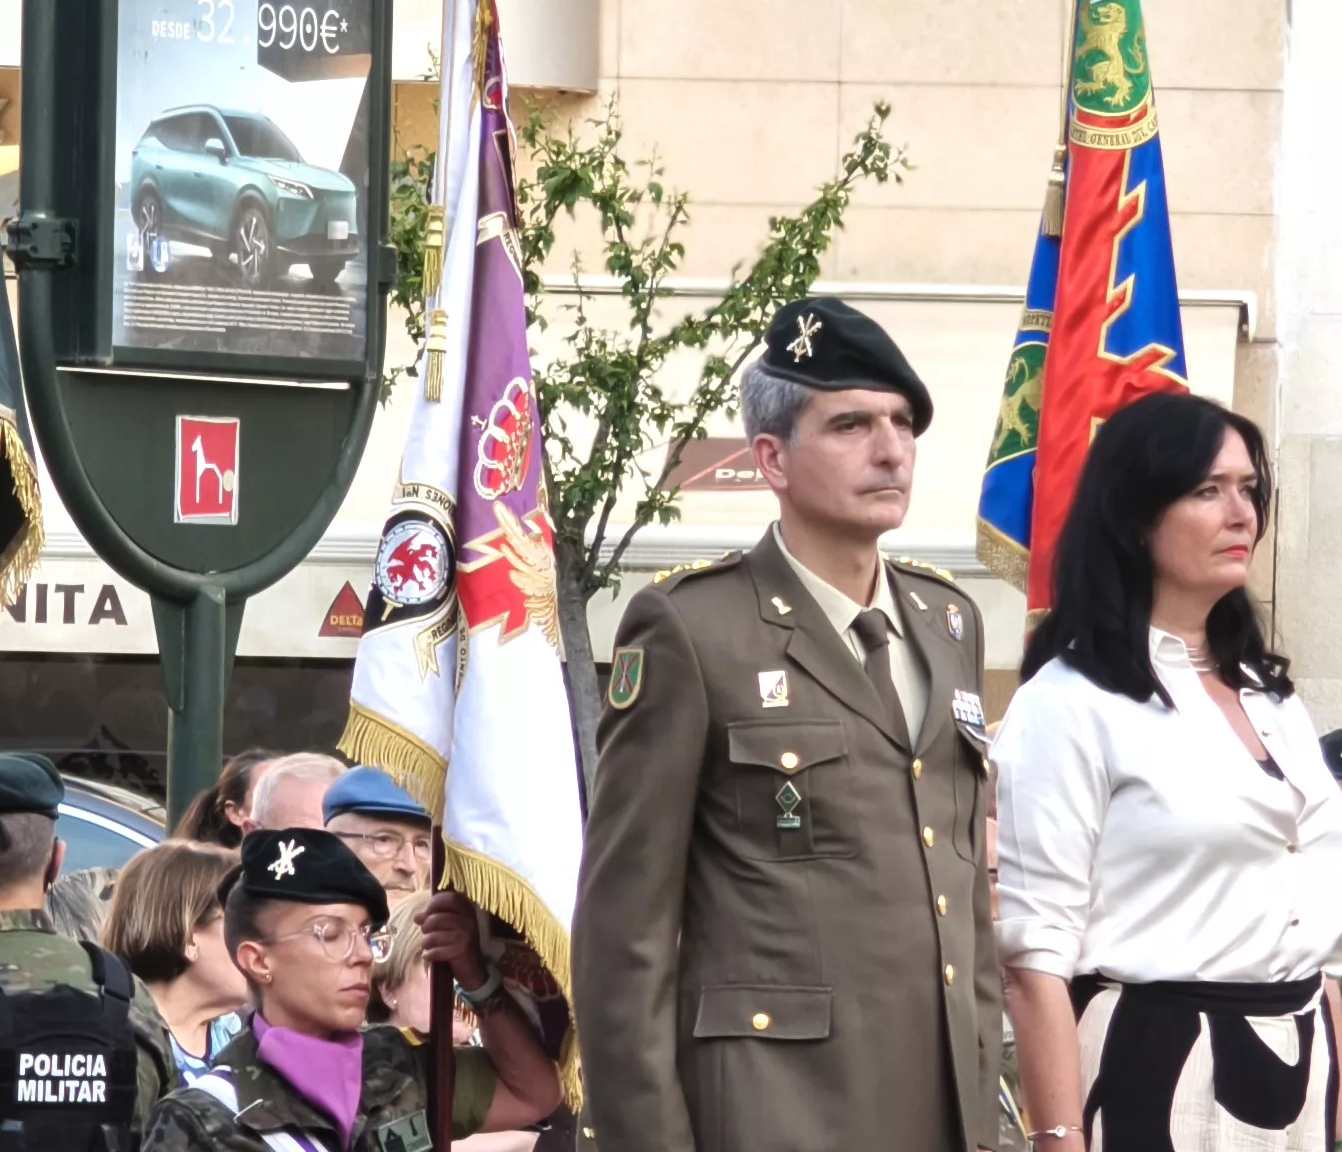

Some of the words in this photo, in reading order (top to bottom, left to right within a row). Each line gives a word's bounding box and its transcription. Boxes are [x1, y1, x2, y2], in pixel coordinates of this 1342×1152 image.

[152, 19, 191, 40] DESDE
[19, 1053, 107, 1077] POLICIA
[17, 1079, 106, 1102] MILITAR
